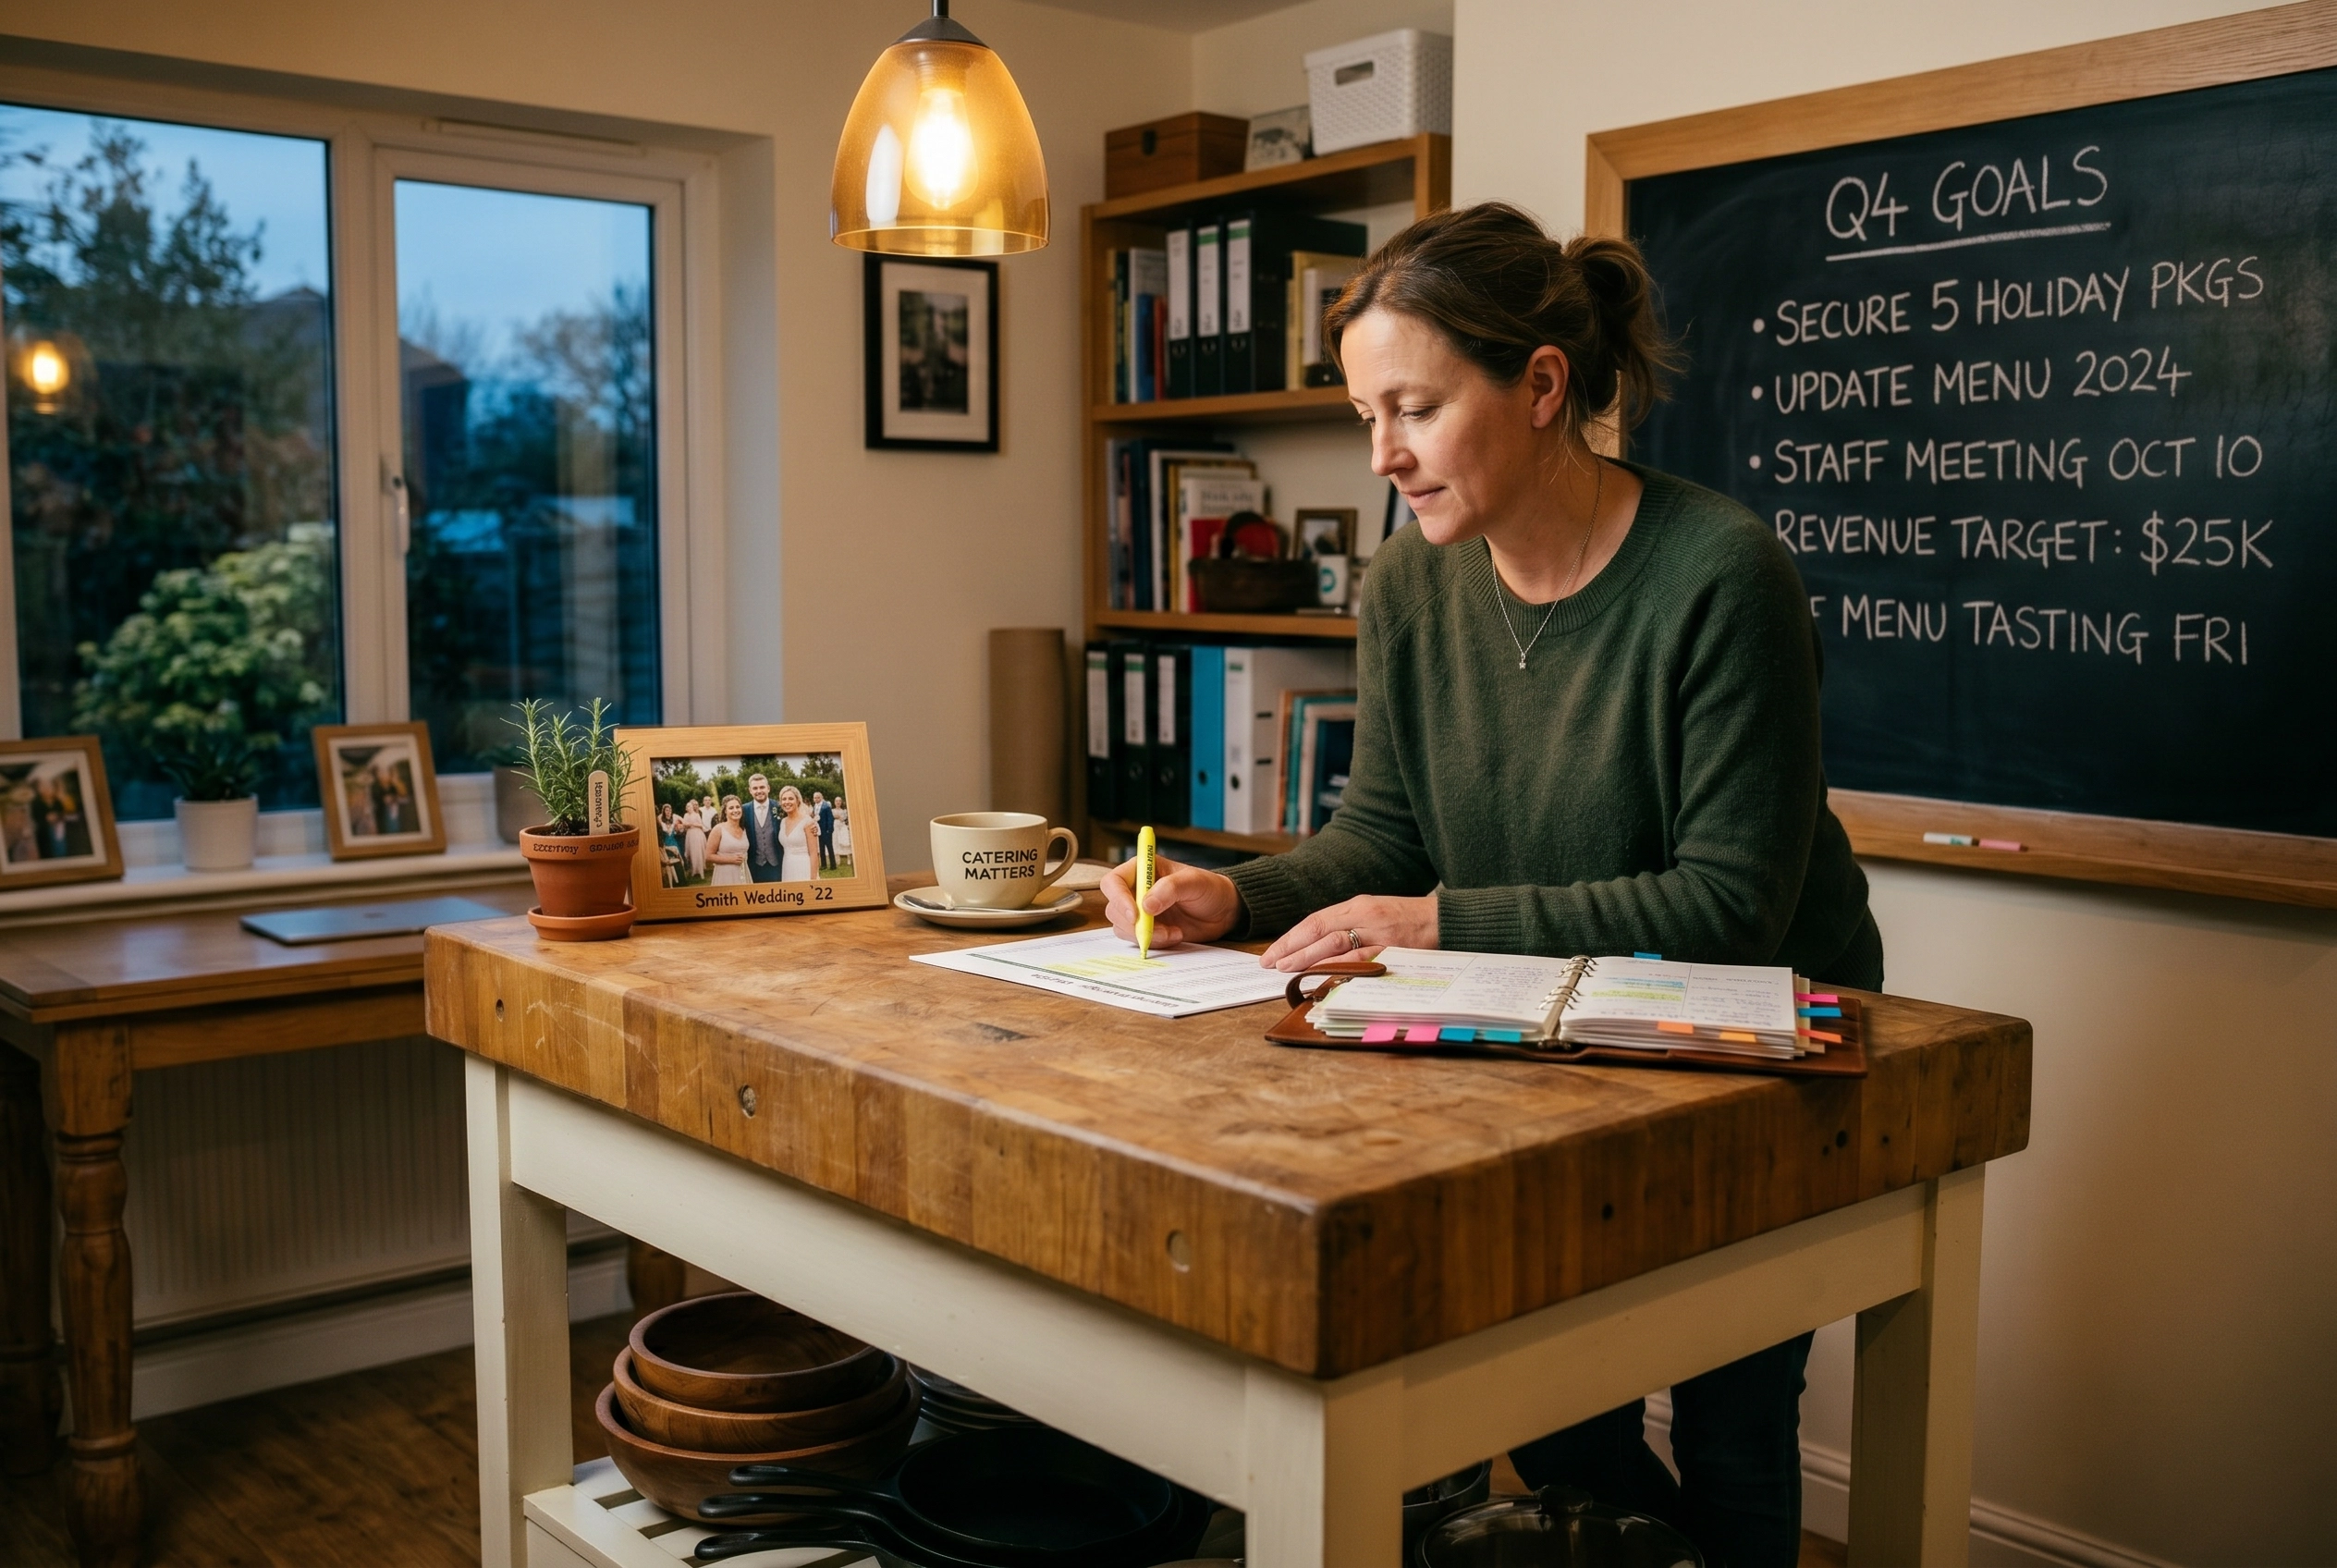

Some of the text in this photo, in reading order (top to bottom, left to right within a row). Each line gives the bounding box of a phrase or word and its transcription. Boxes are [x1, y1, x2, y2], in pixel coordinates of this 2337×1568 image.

[1826, 145, 2108, 241] Q4 GOALS
[1776, 255, 2264, 346] SECURE 5 HOLIDAY PKGS
[1775, 346, 2192, 414] UPDATE MENU 2024
[1775, 435, 2263, 488] STAFF MEETING OCT 10
[1775, 509, 2272, 575] REVENUE TARGET: $25K
[1842, 594, 1946, 642] MENU
[1963, 601, 2148, 664] TASTING
[2174, 614, 2246, 664] FRI
[961, 848, 1038, 864] CATERING
[964, 864, 1035, 880] MATTERS
[695, 891, 739, 909] Smith
[743, 888, 805, 906] Wedding
